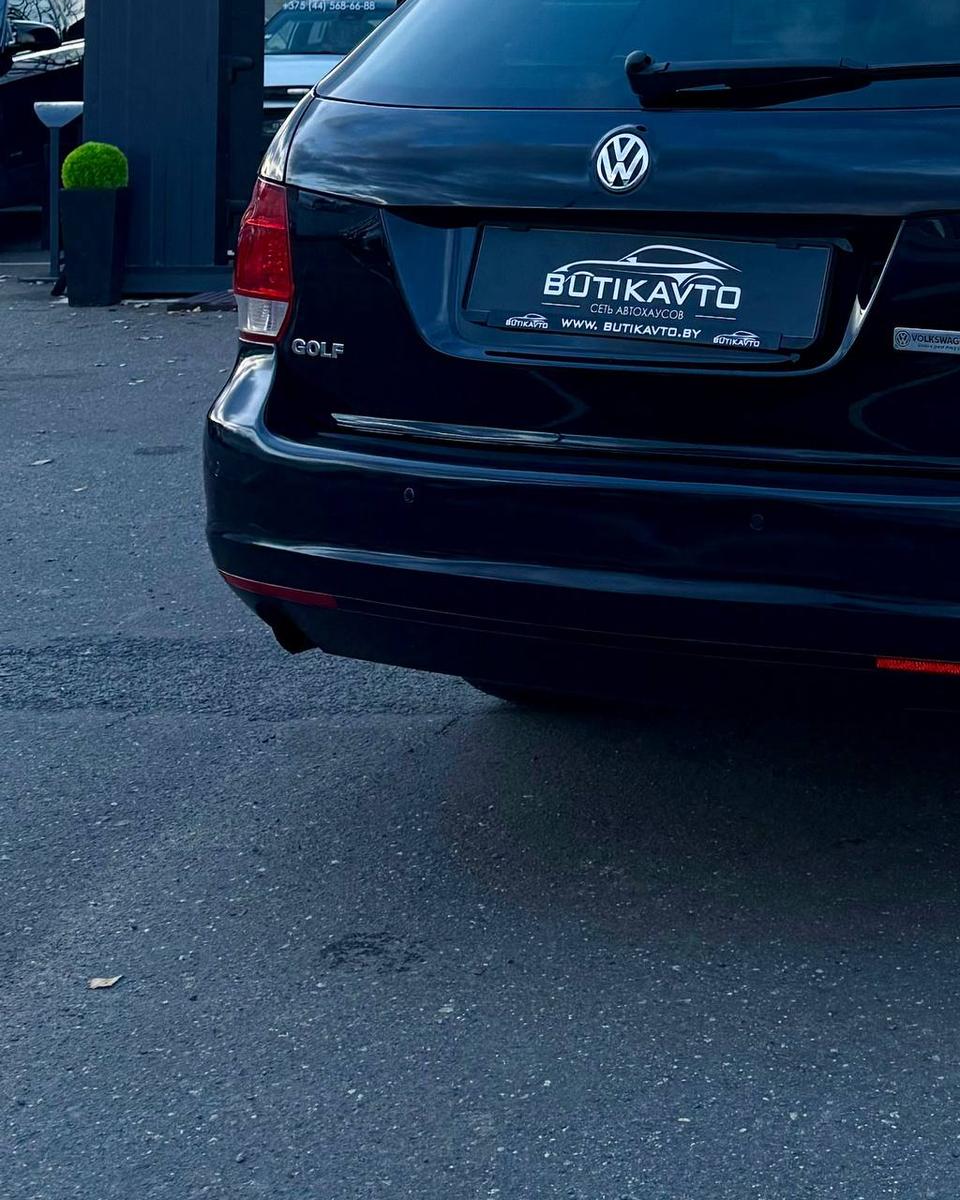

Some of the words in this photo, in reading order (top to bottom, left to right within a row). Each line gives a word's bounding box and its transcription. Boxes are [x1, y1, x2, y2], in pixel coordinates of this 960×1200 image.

[283, 1, 305, 10] +375
[308, 1, 326, 12] (44)
[329, 1, 376, 10] 568-66-88
[543, 272, 742, 310] BUTIKAVTO
[590, 303, 614, 315] СЕТЬ
[615, 305, 685, 320] АВТОХАУСОВ
[505, 317, 549, 329] BUTIKAVTO
[561, 318, 598, 331] WWW.
[603, 323, 702, 340] BUTIKAVTO.BY
[291, 338, 345, 359] GOLF
[713, 335, 760, 348] BUTIKAVTO
